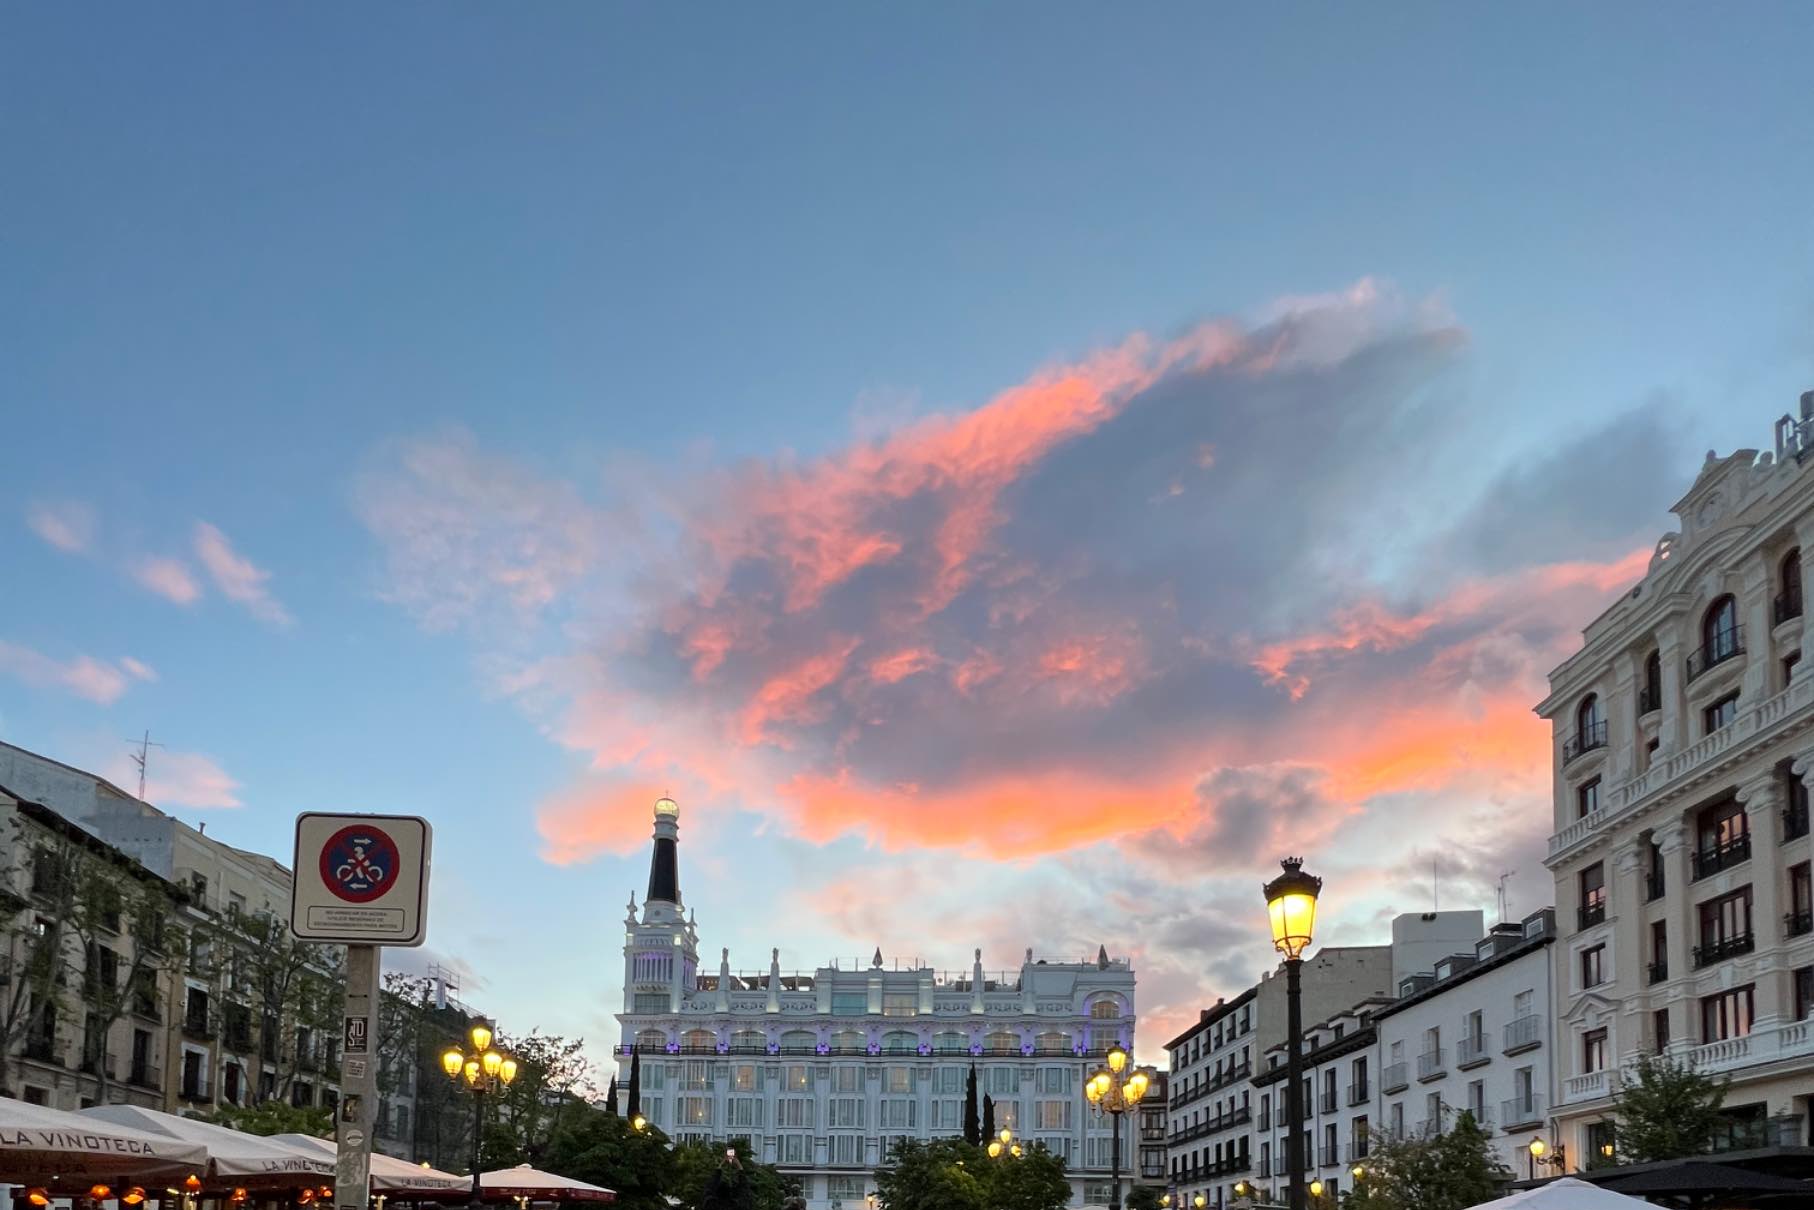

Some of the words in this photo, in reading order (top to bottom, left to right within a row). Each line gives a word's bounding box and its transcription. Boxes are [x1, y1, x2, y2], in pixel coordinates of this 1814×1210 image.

[0, 1131, 33, 1146] LA
[39, 1132, 157, 1156] VINOTECA
[262, 1160, 280, 1171] LA
